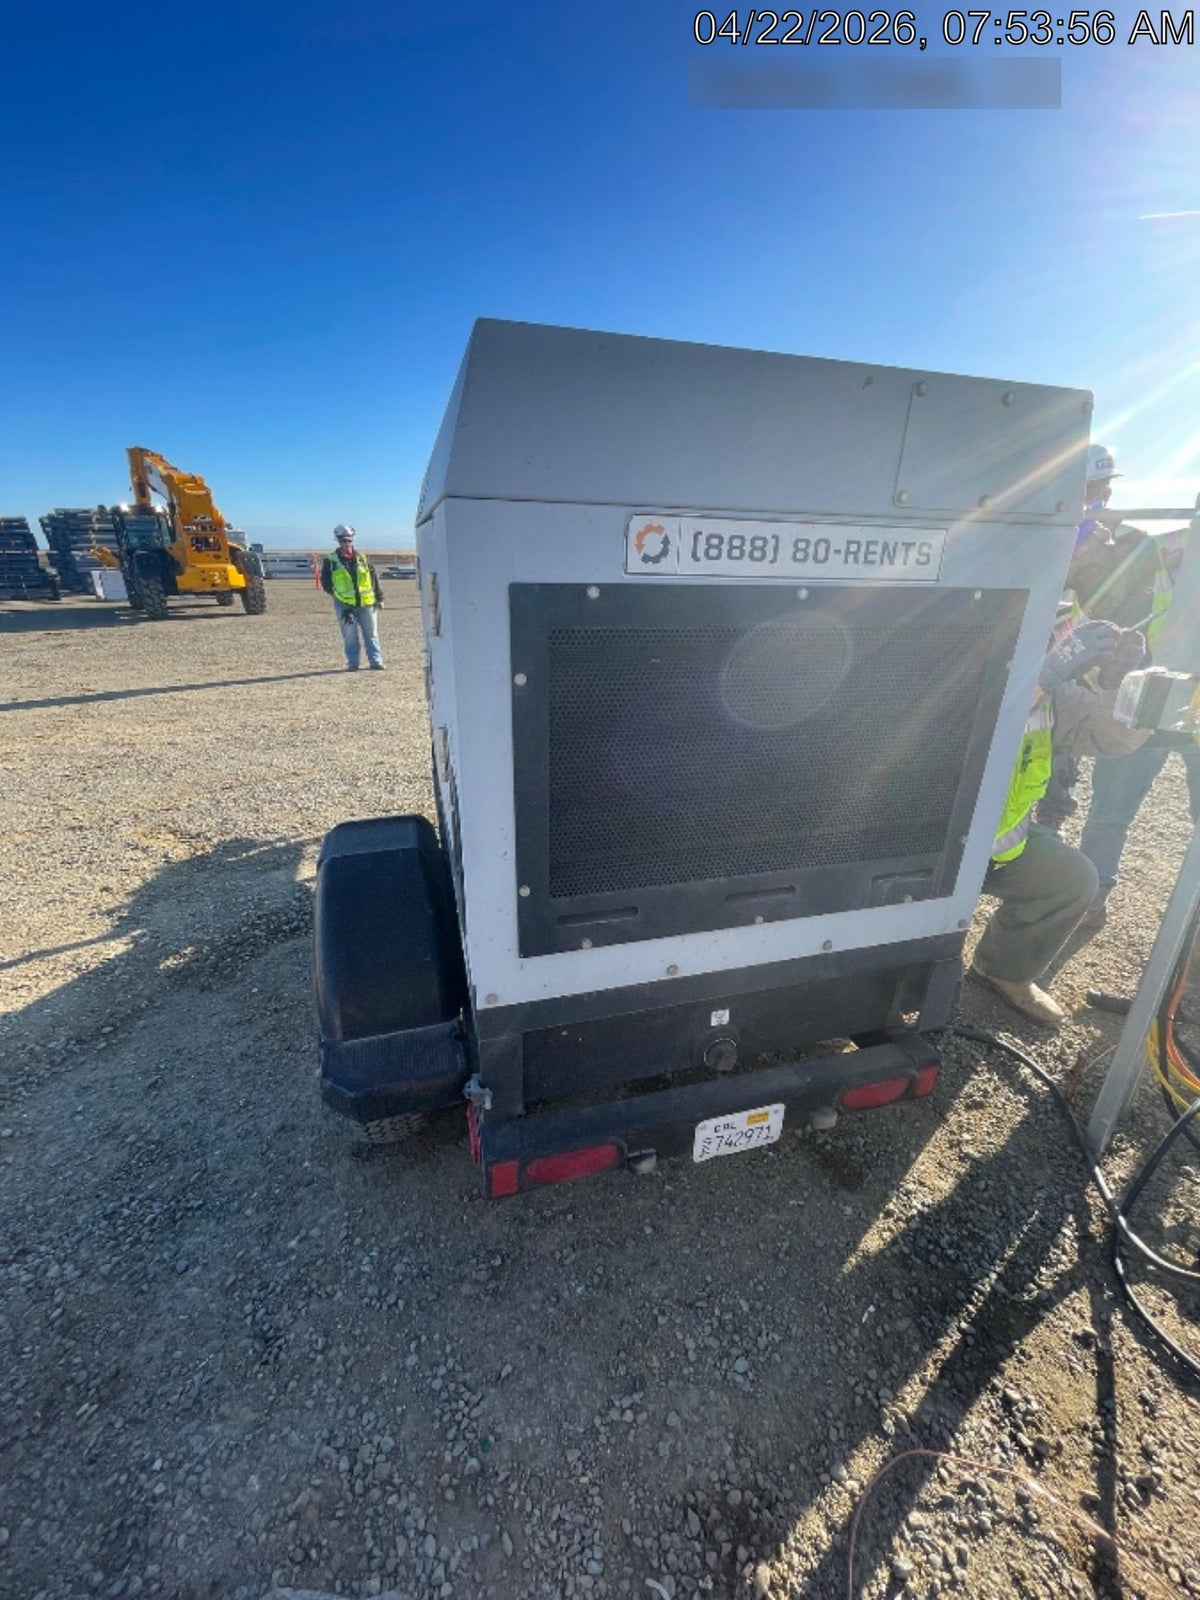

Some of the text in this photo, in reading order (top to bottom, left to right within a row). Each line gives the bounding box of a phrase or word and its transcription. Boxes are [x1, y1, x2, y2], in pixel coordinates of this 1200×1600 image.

[692, 531, 933, 567] (888) 80-RENTS
[715, 1124, 775, 1151] 742971
